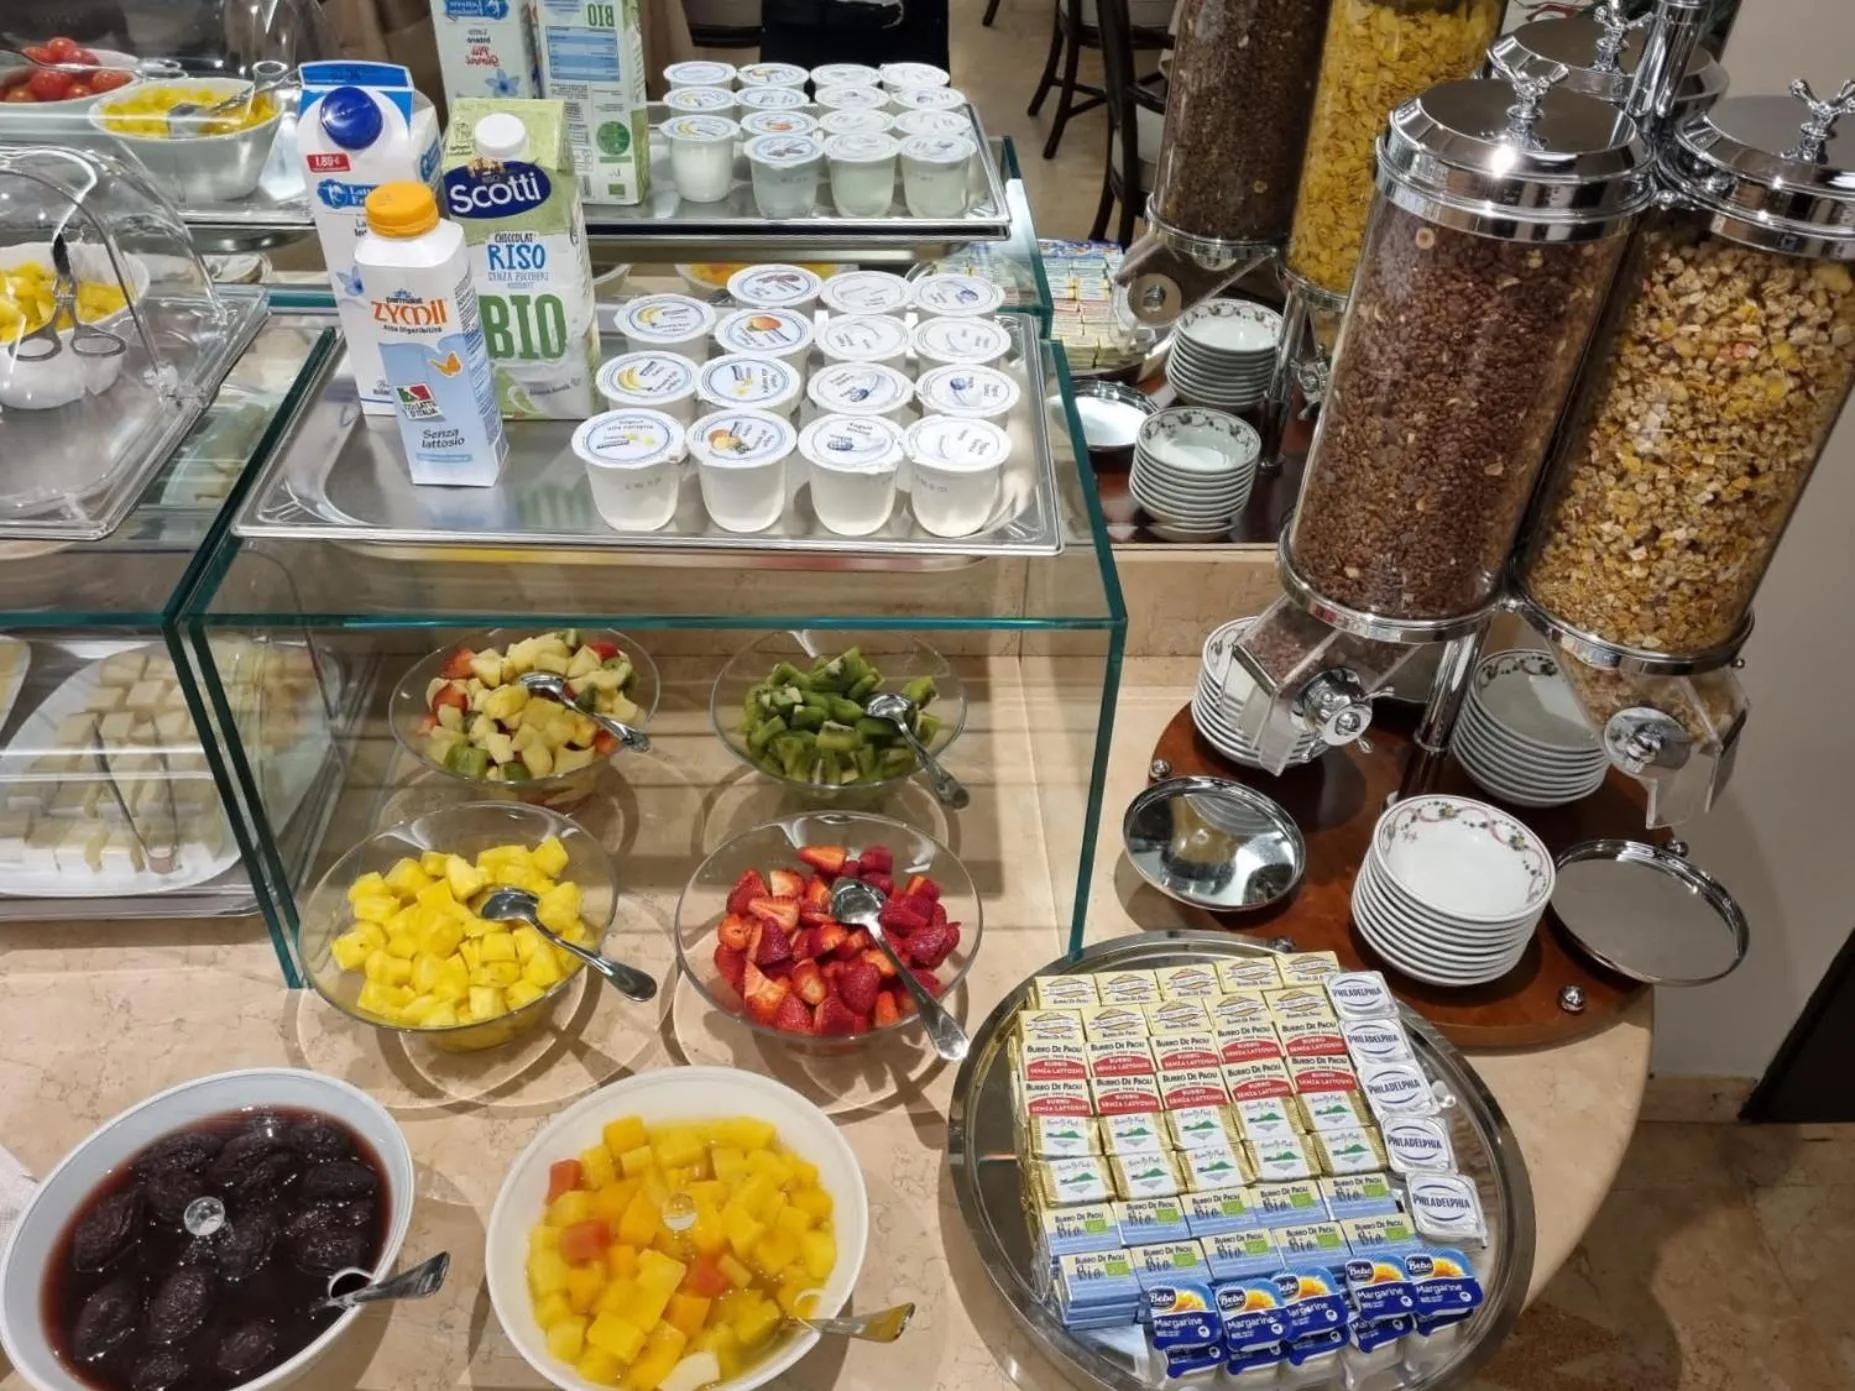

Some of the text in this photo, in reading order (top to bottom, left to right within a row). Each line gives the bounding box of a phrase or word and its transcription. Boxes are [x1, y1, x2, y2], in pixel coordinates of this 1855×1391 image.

[450, 172, 541, 213] Scotti
[487, 244, 546, 271] RISO
[478, 293, 568, 359] BIO
[423, 429, 459, 439] Senza
[422, 438, 465, 449] lattosio
[1332, 987, 1383, 998] PHILADELPHIA
[1347, 1033, 1400, 1043] PHILADELPHIA
[1366, 1079, 1421, 1094] PHILADELPHIA
[1387, 1134, 1443, 1149] PHILADELPHIA
[1412, 1193, 1471, 1209] PHILADELPHIA
[1356, 1287, 1404, 1299] Margarine
[1416, 1283, 1462, 1294] Margarine
[1154, 1317, 1203, 1329] Margarine
[1227, 1315, 1277, 1330] Margarine
